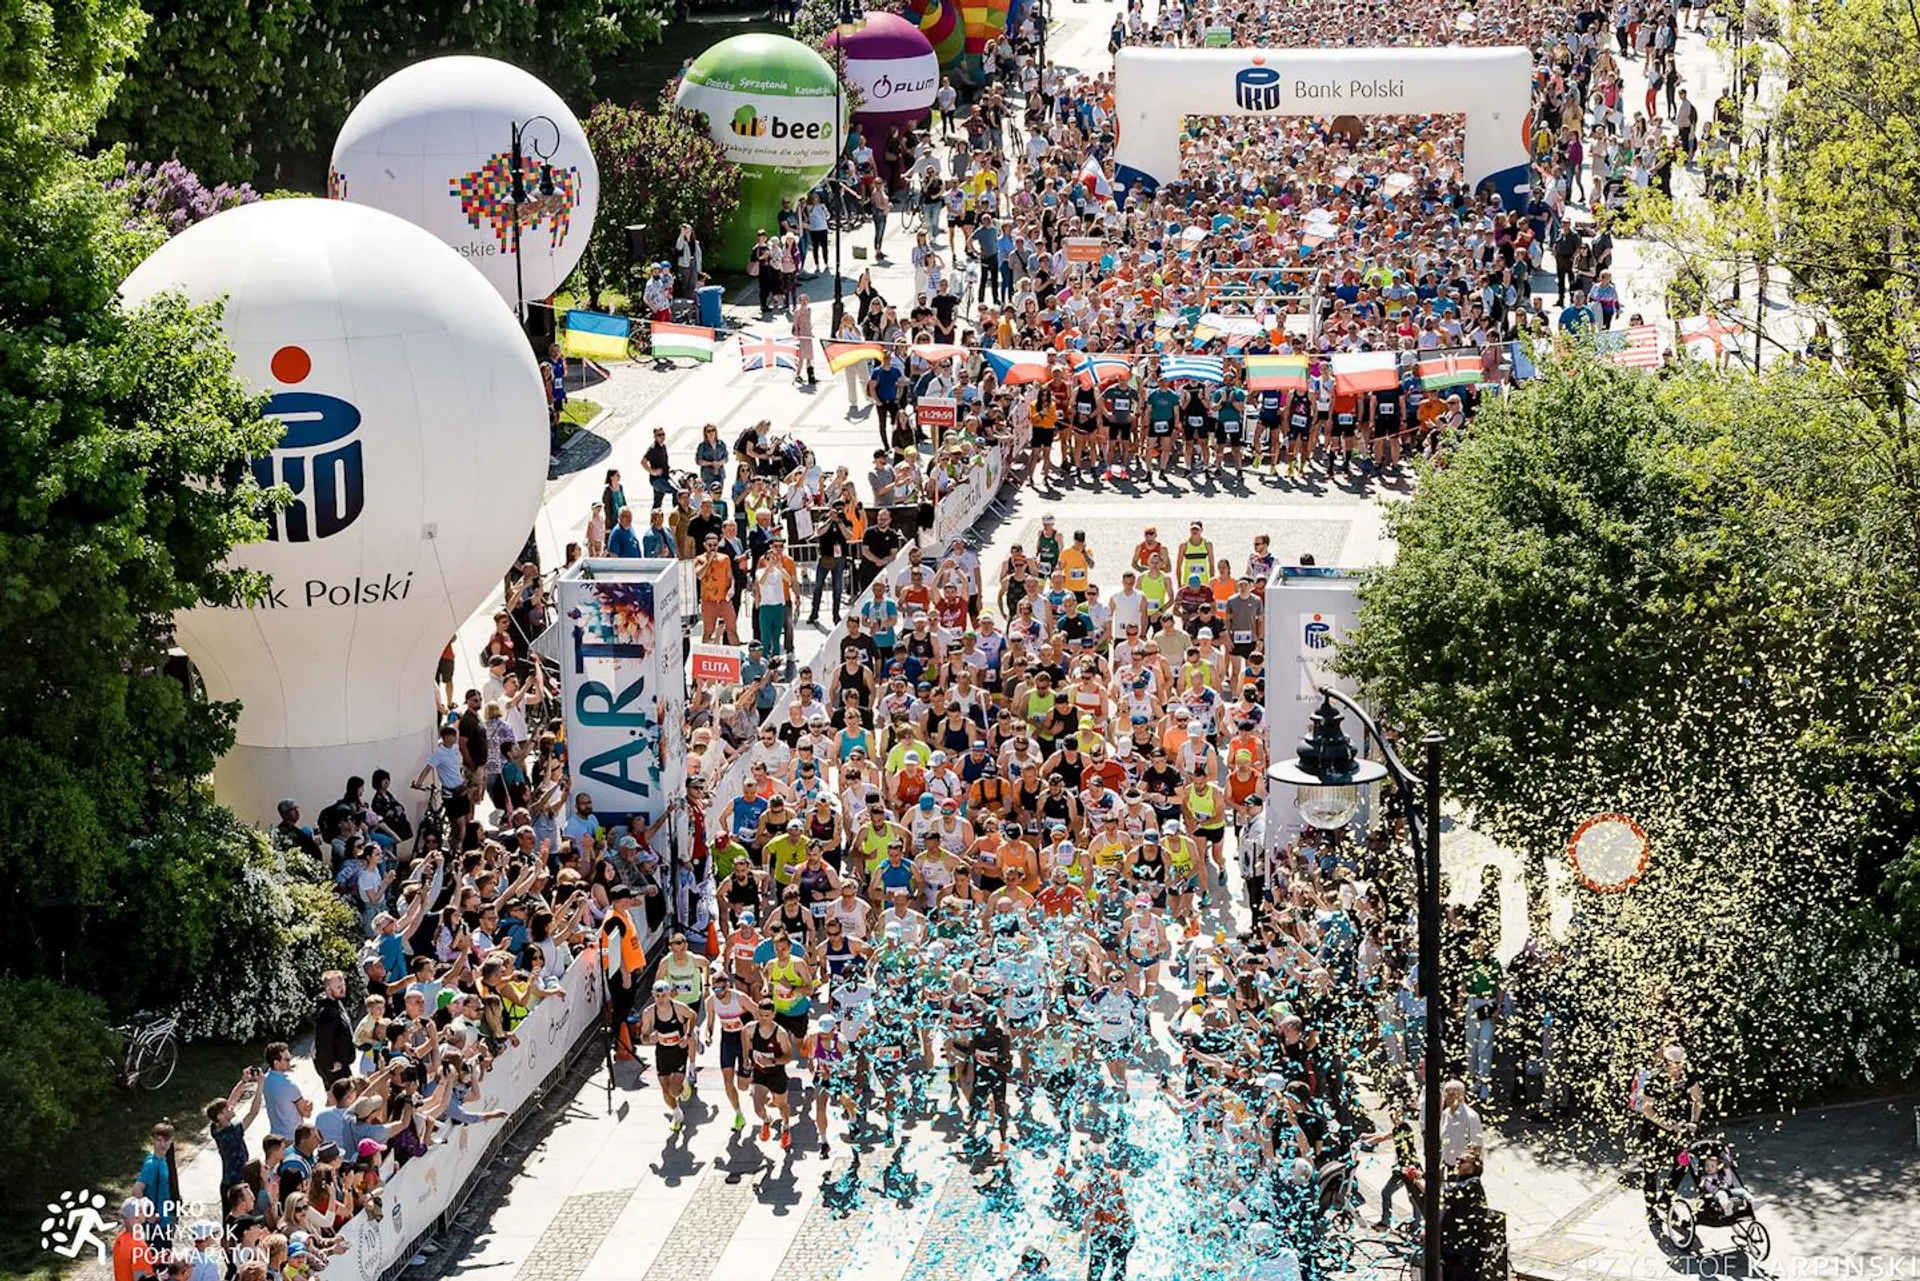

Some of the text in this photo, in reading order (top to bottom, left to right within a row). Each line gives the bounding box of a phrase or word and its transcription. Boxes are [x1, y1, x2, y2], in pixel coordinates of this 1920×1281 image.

[1295, 80, 1342, 99] Bank
[1350, 79, 1404, 98] Polski
[305, 571, 413, 607] Polski
[702, 660, 731, 673] ELITA
